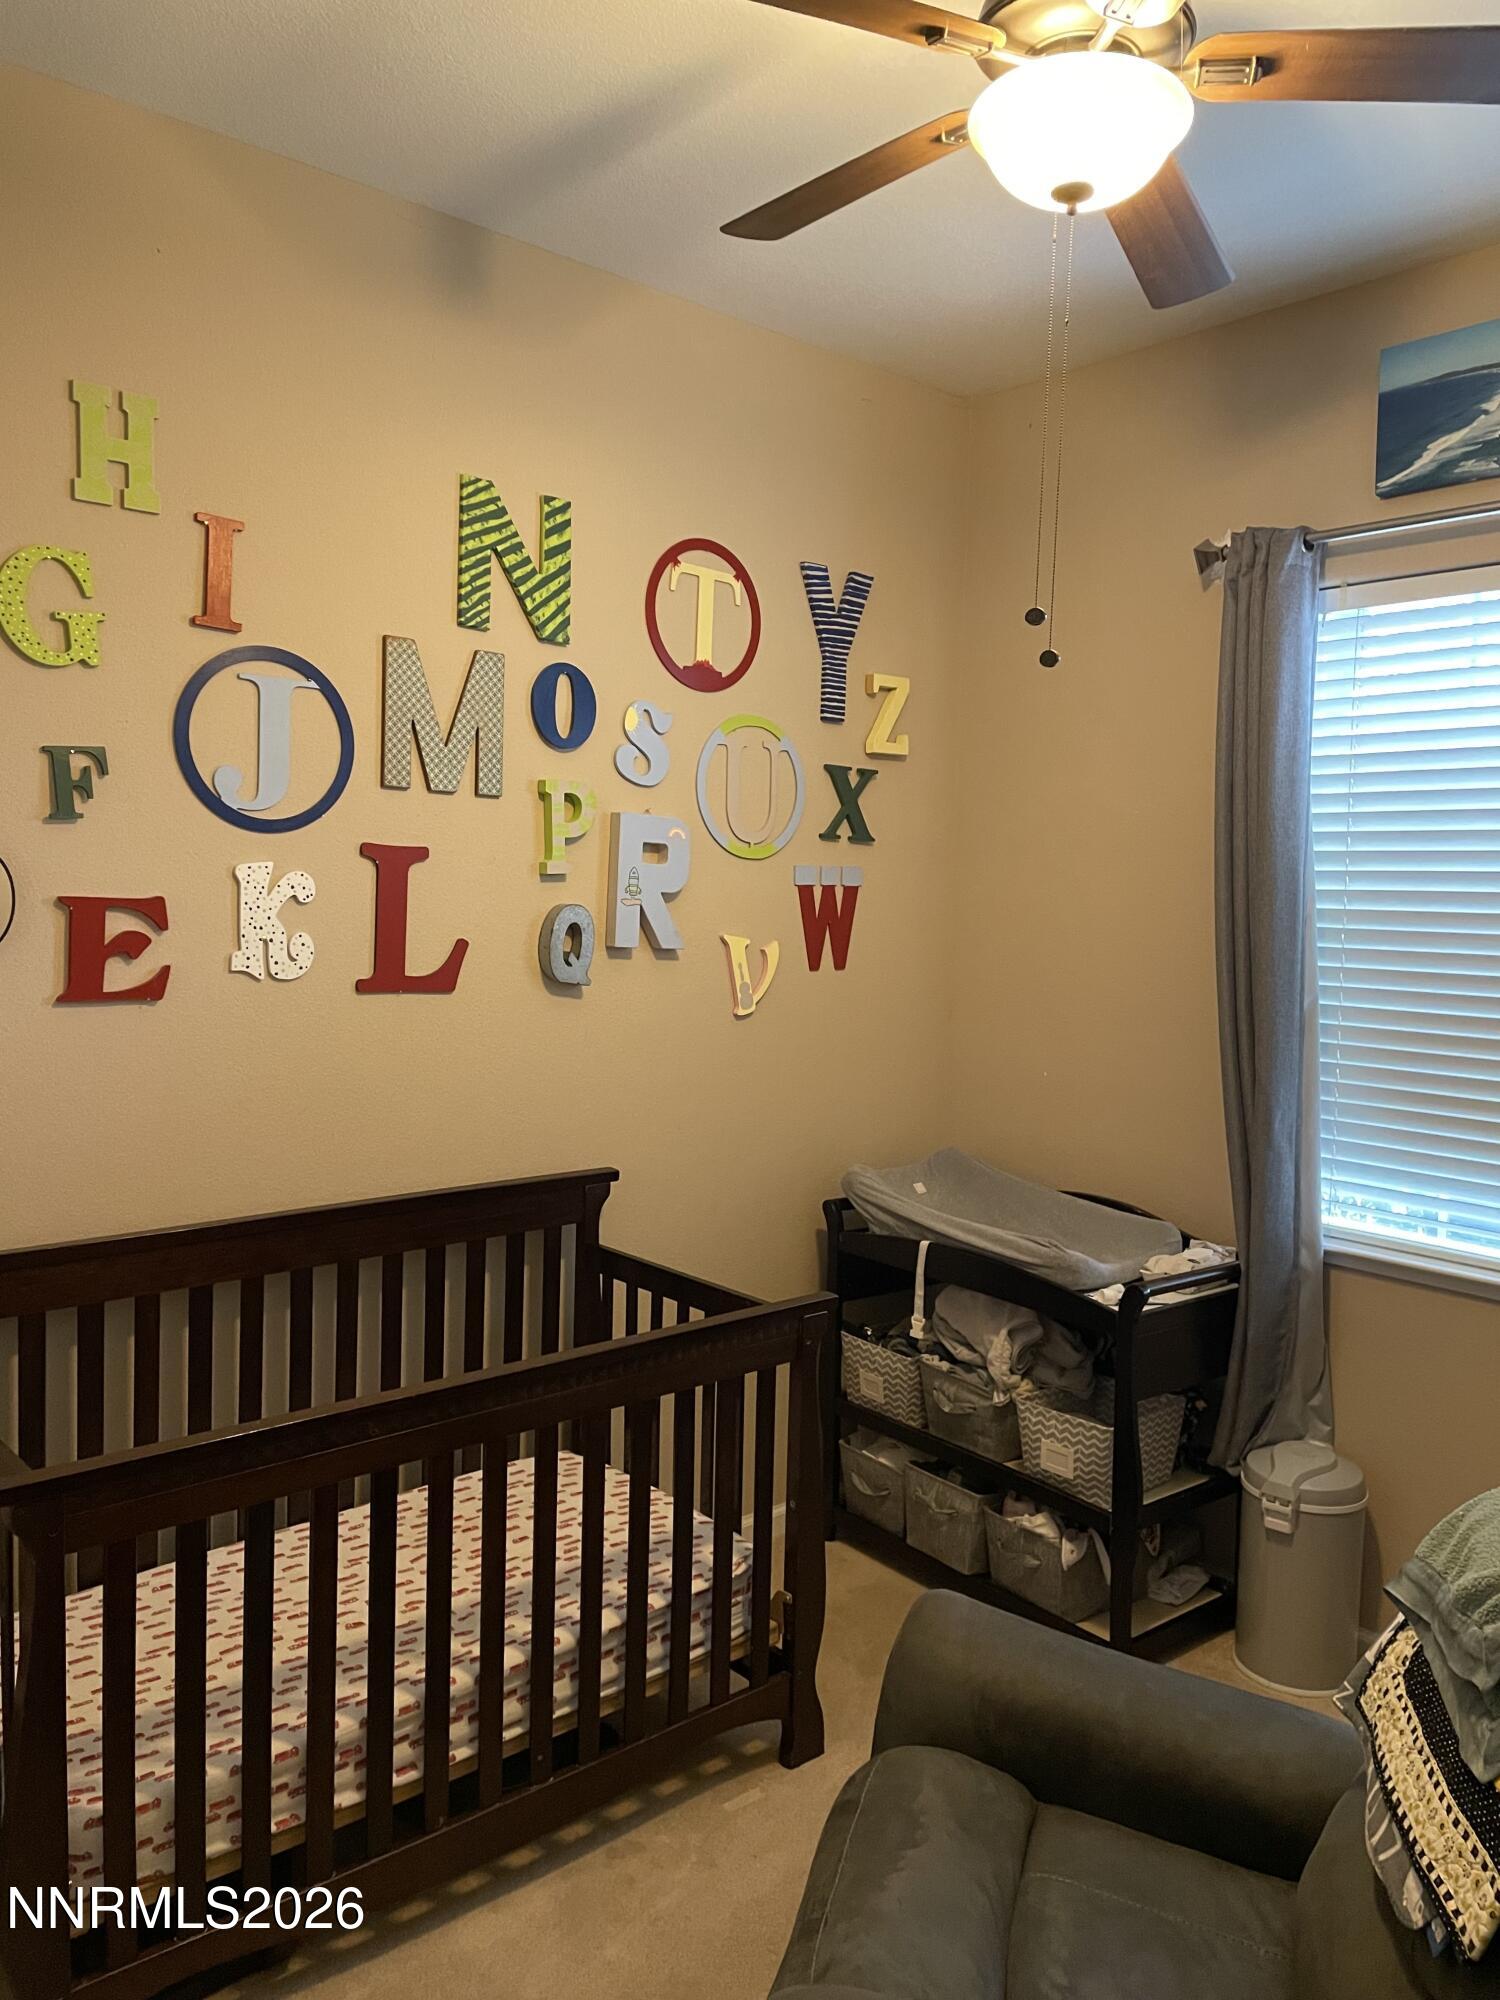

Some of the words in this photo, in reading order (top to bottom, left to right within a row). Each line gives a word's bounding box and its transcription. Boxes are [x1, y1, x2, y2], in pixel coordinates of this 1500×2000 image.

[69, 379, 160, 514] H
[0, 545, 104, 667] G
[193, 512, 244, 632] I
[457, 473, 572, 644] N
[669, 560, 742, 686] T
[800, 561, 875, 723] Y
[211, 673, 321, 811] J
[381, 634, 505, 798] M
[531, 662, 597, 752] O
[614, 700, 673, 787] S
[865, 673, 910, 755] Z
[42, 745, 109, 824] F
[538, 778, 598, 876] P
[716, 740, 789, 846] U
[818, 763, 879, 844] X
[230, 861, 316, 981] K
[354, 842, 470, 994] L
[606, 812, 691, 951] R
[794, 865, 864, 972] W
[56, 895, 172, 1004] E
[538, 904, 595, 988] Q
